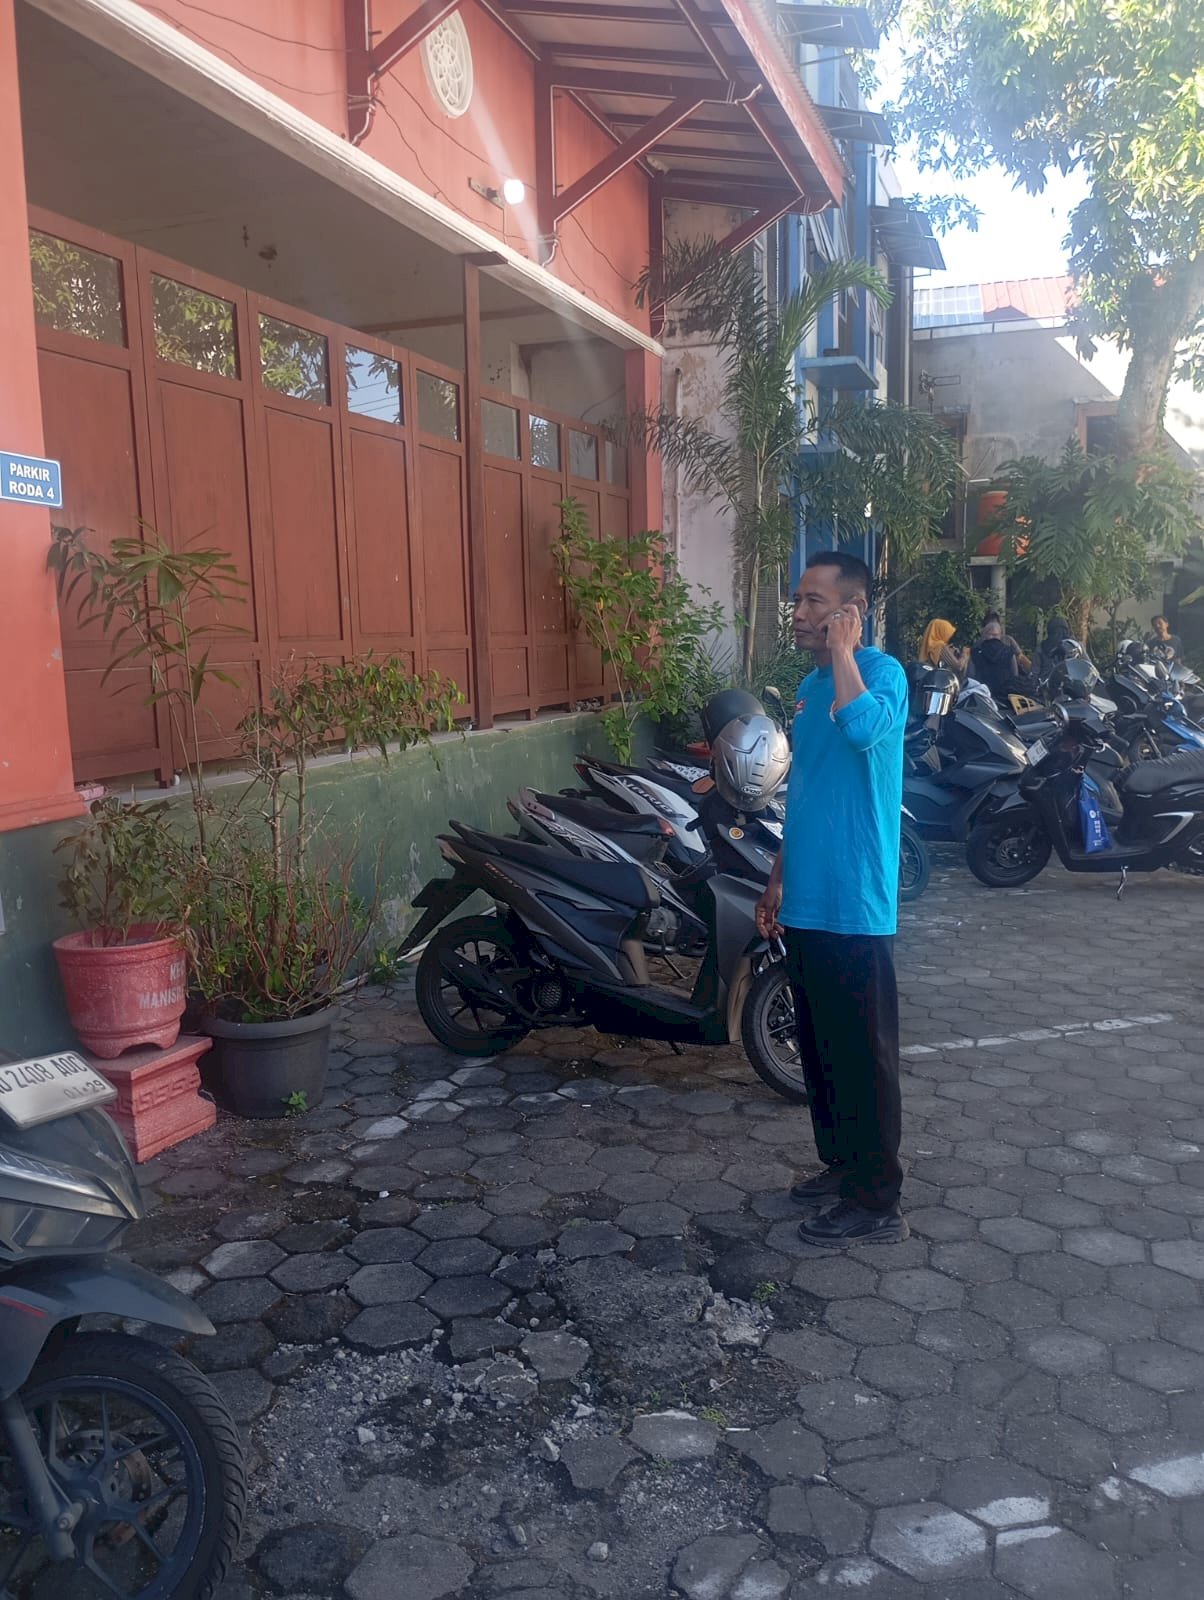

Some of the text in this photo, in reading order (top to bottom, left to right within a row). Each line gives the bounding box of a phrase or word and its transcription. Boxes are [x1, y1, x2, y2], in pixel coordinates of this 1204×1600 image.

[9, 463, 50, 482] PARKIR
[9, 481, 55, 499] RODA 4
[5, 1063, 55, 1088] 2408
